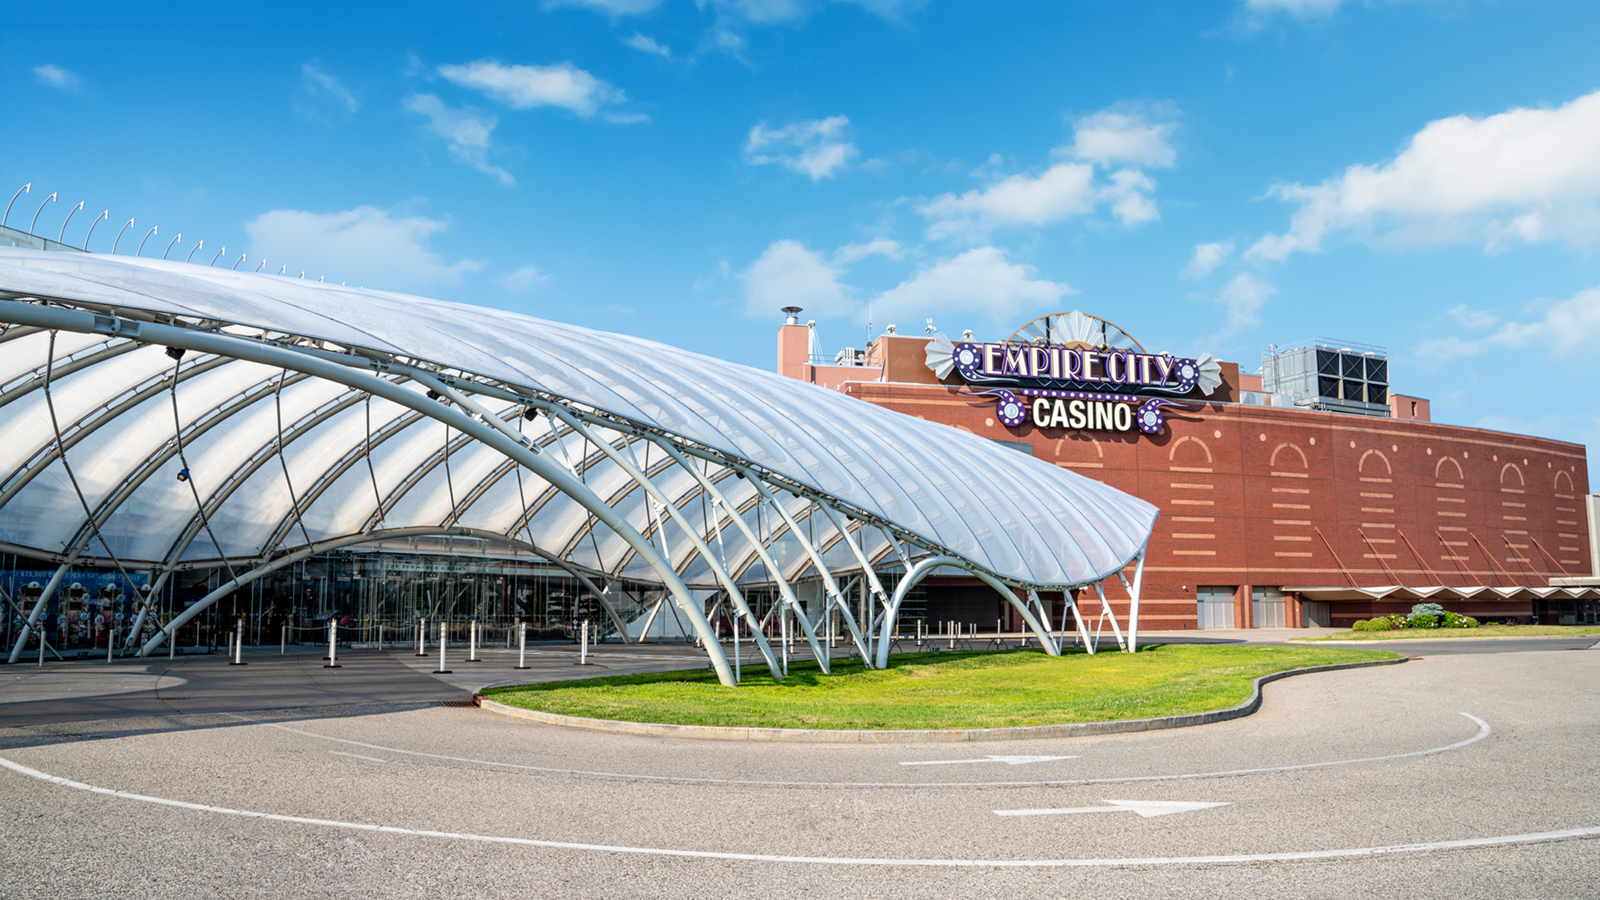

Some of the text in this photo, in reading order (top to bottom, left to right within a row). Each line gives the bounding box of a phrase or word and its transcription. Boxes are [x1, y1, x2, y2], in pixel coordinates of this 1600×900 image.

[982, 343, 1175, 388] EMPIRE CITY
[1032, 397, 1132, 431] CASINO
